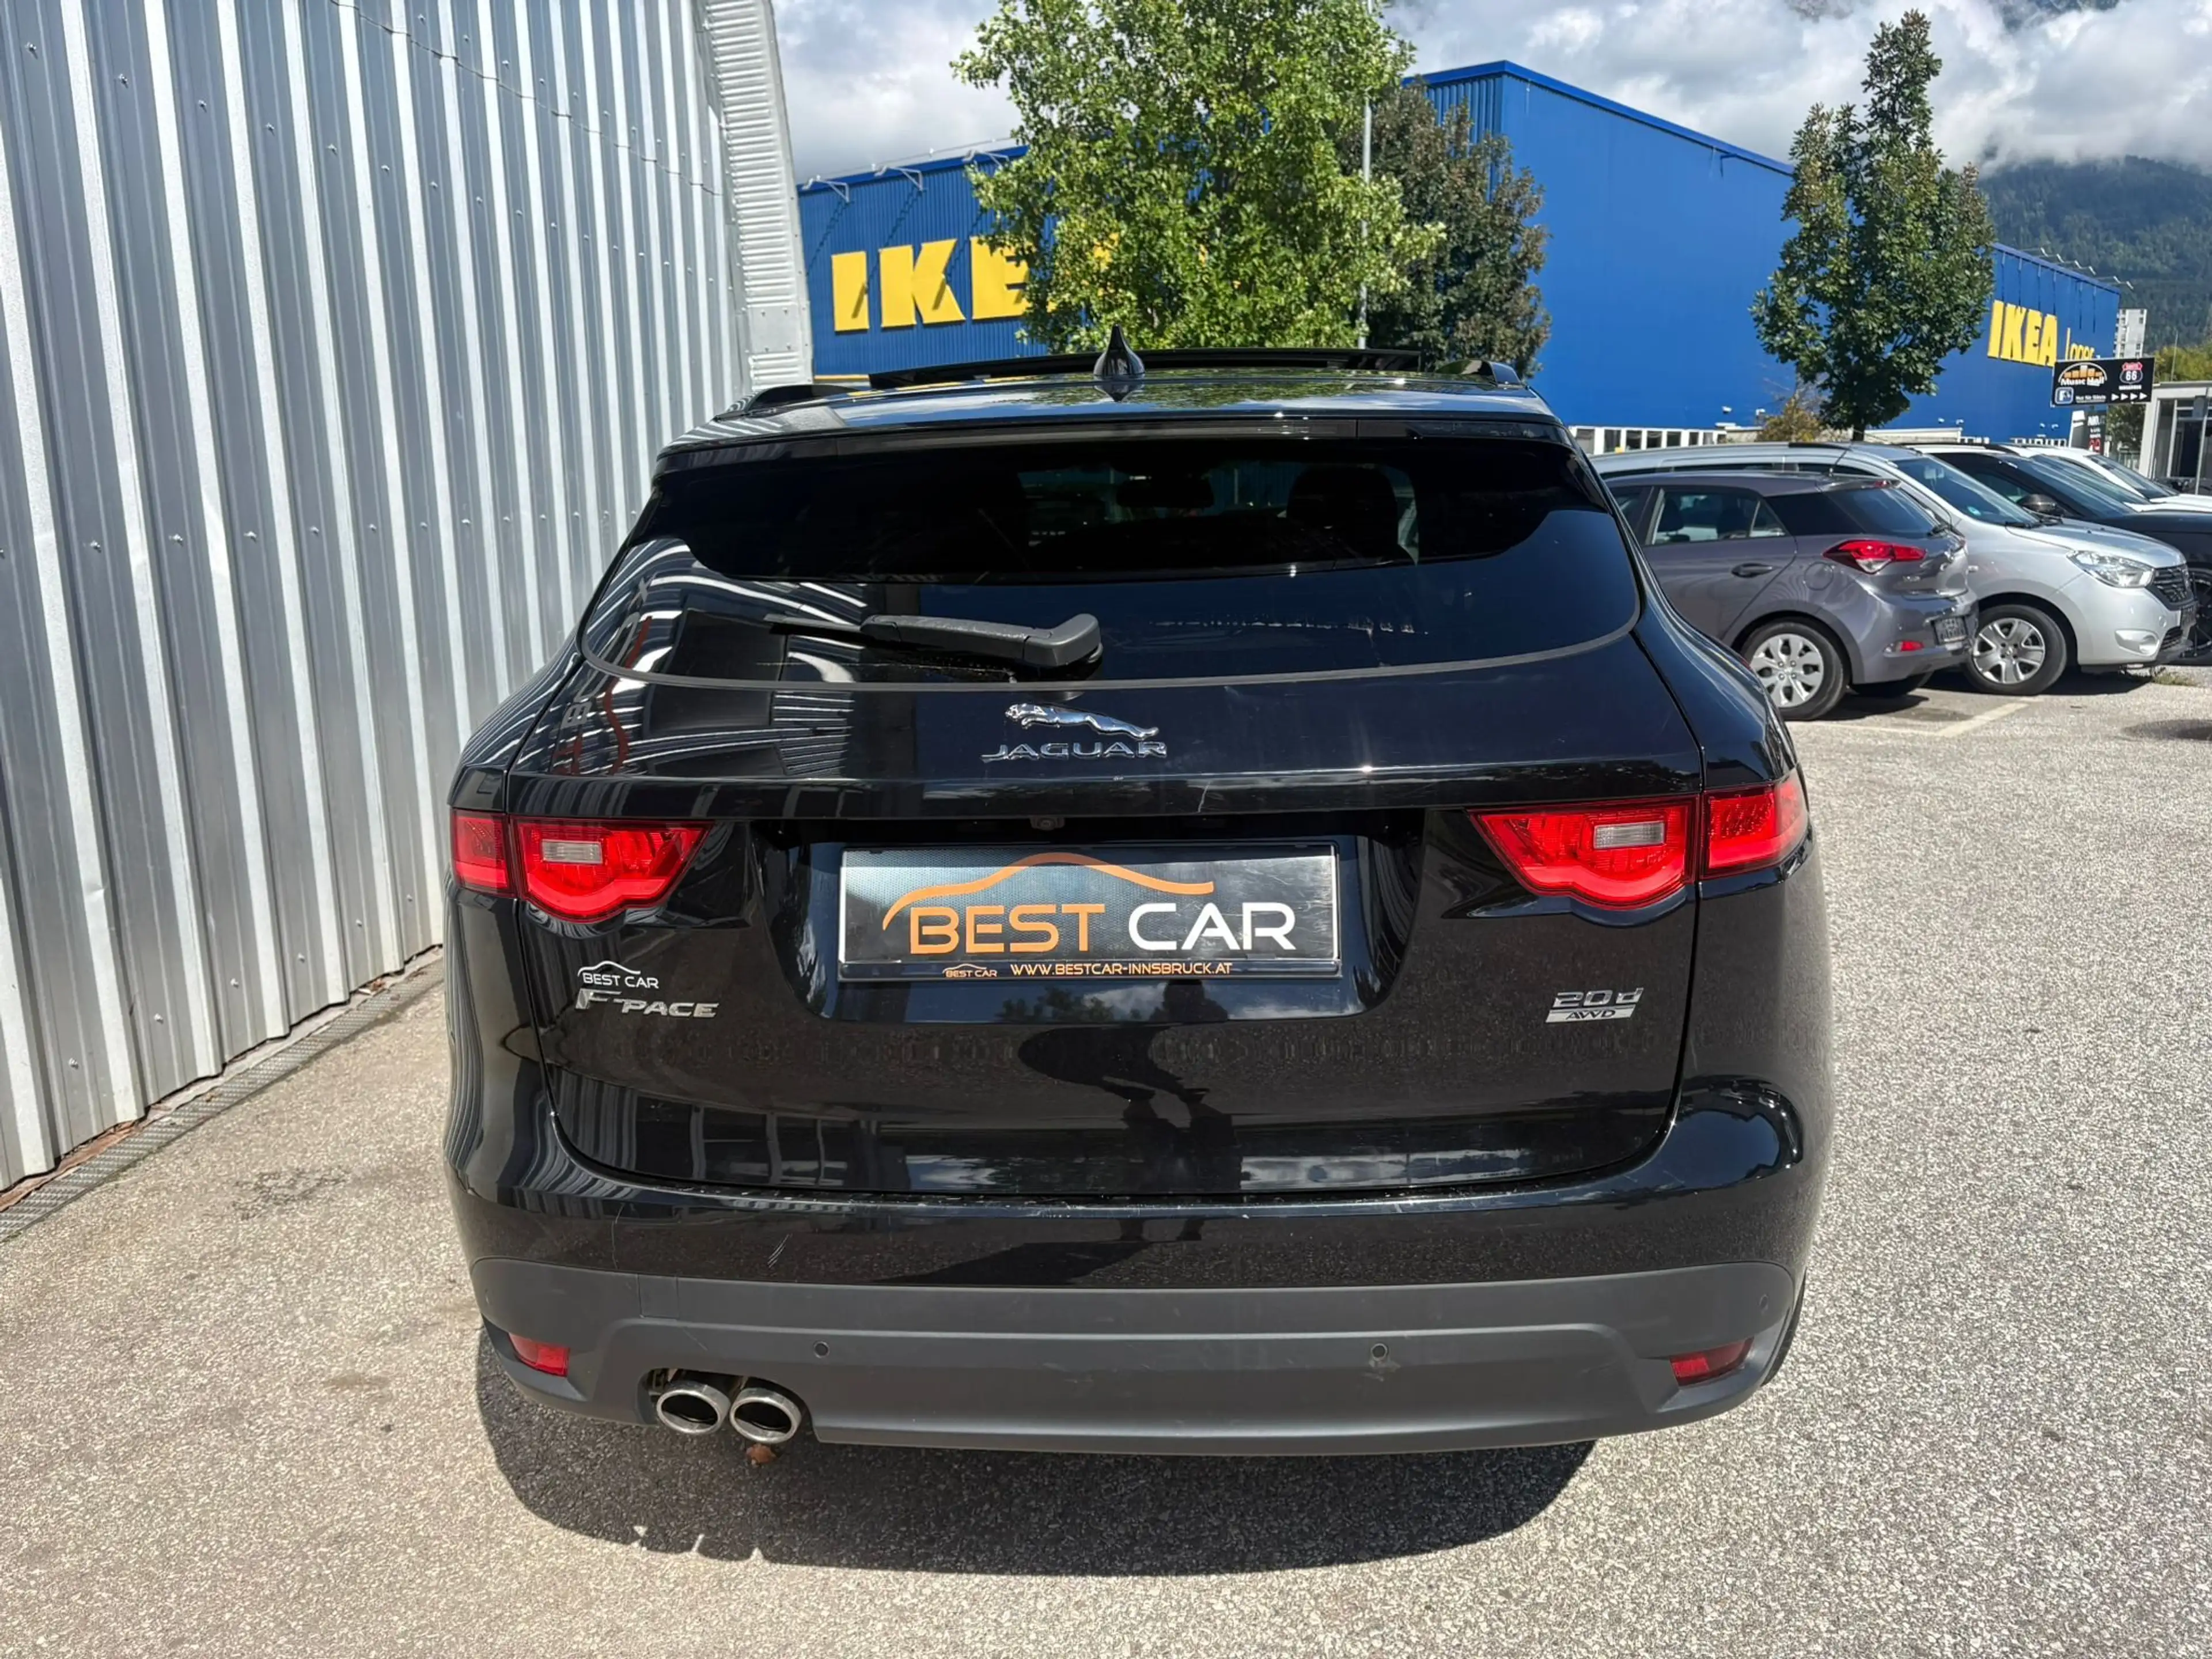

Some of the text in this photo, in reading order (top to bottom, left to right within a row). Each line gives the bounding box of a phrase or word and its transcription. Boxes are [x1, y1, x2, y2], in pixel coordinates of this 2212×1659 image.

[832, 234, 1119, 332] IKE
[1987, 299, 2058, 368] IKEA
[980, 741, 1167, 763] JAGUAR
[910, 902, 1296, 954] BEST CAR
[974, 969, 998, 978] CAR
[1010, 962, 1233, 976] WWW.BESTCAR-INNSBRUCK.AT
[582, 972, 659, 989] BEST CAR
[575, 988, 719, 1018] F-PACE
[1565, 1009, 1616, 1020] AWD
